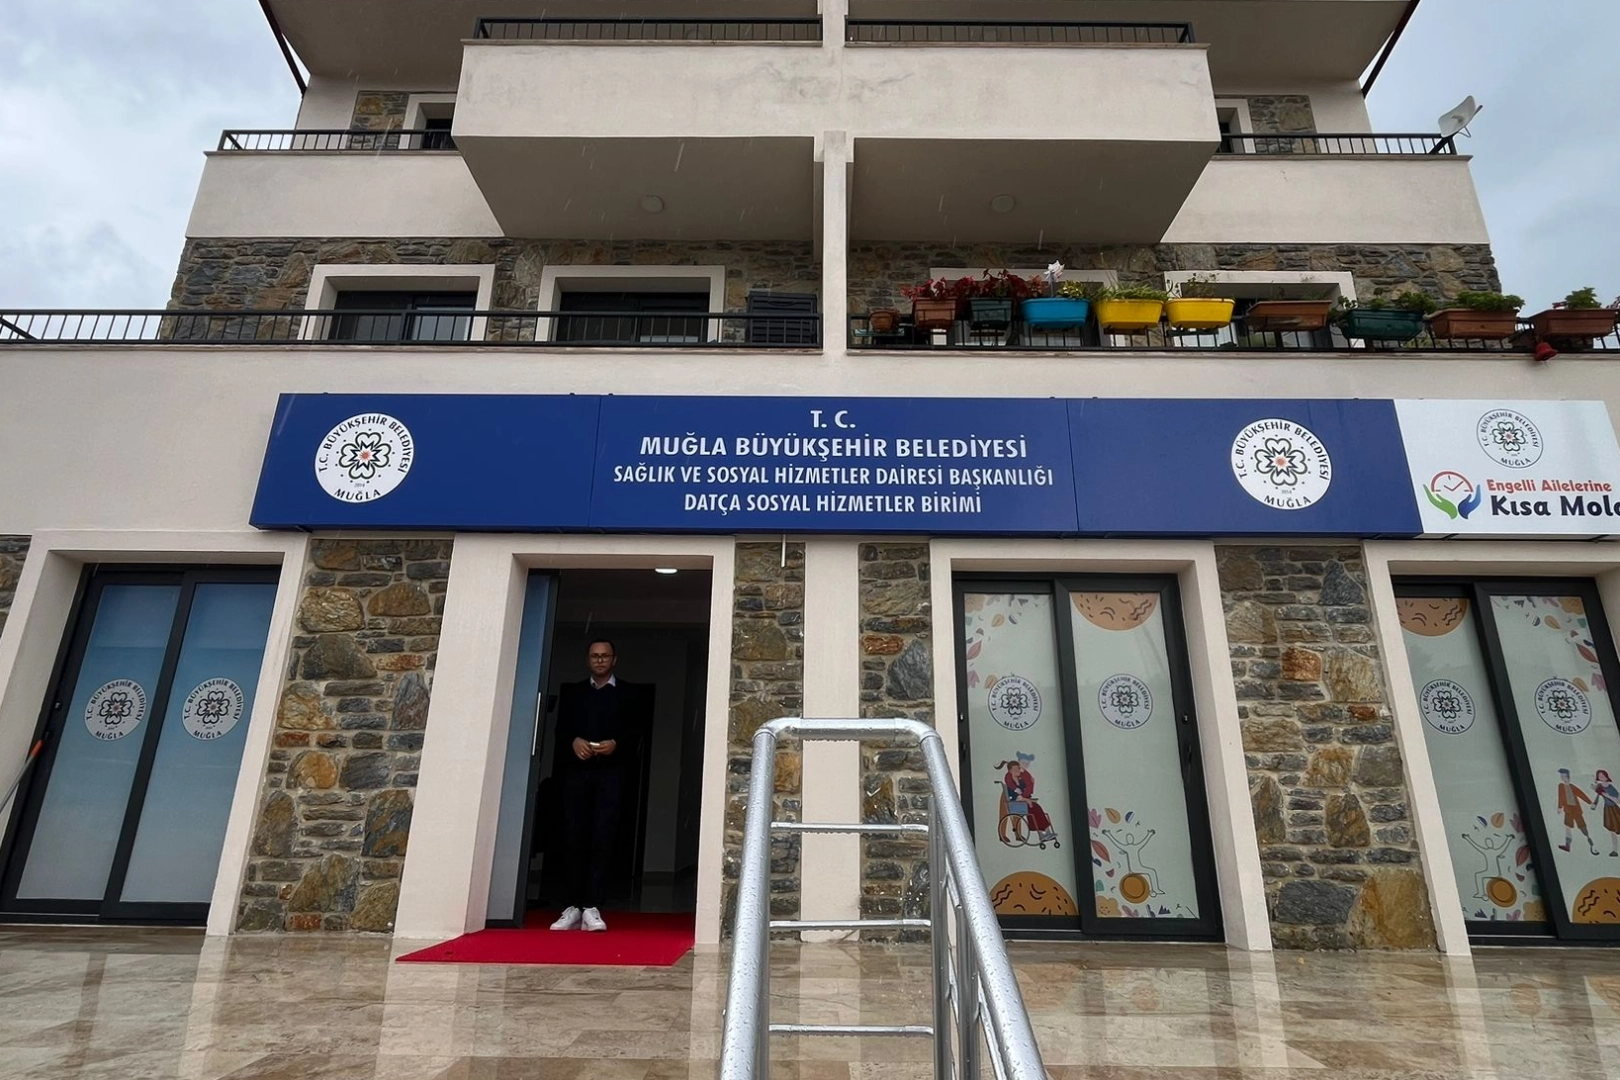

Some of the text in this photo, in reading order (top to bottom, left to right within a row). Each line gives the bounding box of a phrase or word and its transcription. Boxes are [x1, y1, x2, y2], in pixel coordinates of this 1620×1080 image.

[810, 410, 856, 428] T. C.
[323, 415, 388, 450] BÜYÜKŞEHİR
[388, 421, 413, 473] BELEDİYESİ
[640, 432, 1027, 462] MUĞLA BÜYÜKŞEHİR BELEDİYESİ
[1235, 421, 1291, 456] BÜYÜKŞEHİR
[1294, 427, 1330, 481] BELEDİYESİ
[1501, 457, 1531, 466] MUĞLA
[613, 462, 1054, 491] SAĞLIK VE SOSYAL HİZMETLER DAİRESİ BAŞKANLIĞI
[1486, 479, 1613, 494] Engelli Ailelerine
[334, 488, 381, 501] MUĞLA
[684, 490, 982, 516] DATÇA SOSYAL HİZMETLER BİRİMİ
[1264, 494, 1312, 508] MUĞLA
[1491, 495, 1551, 517] Kısa
